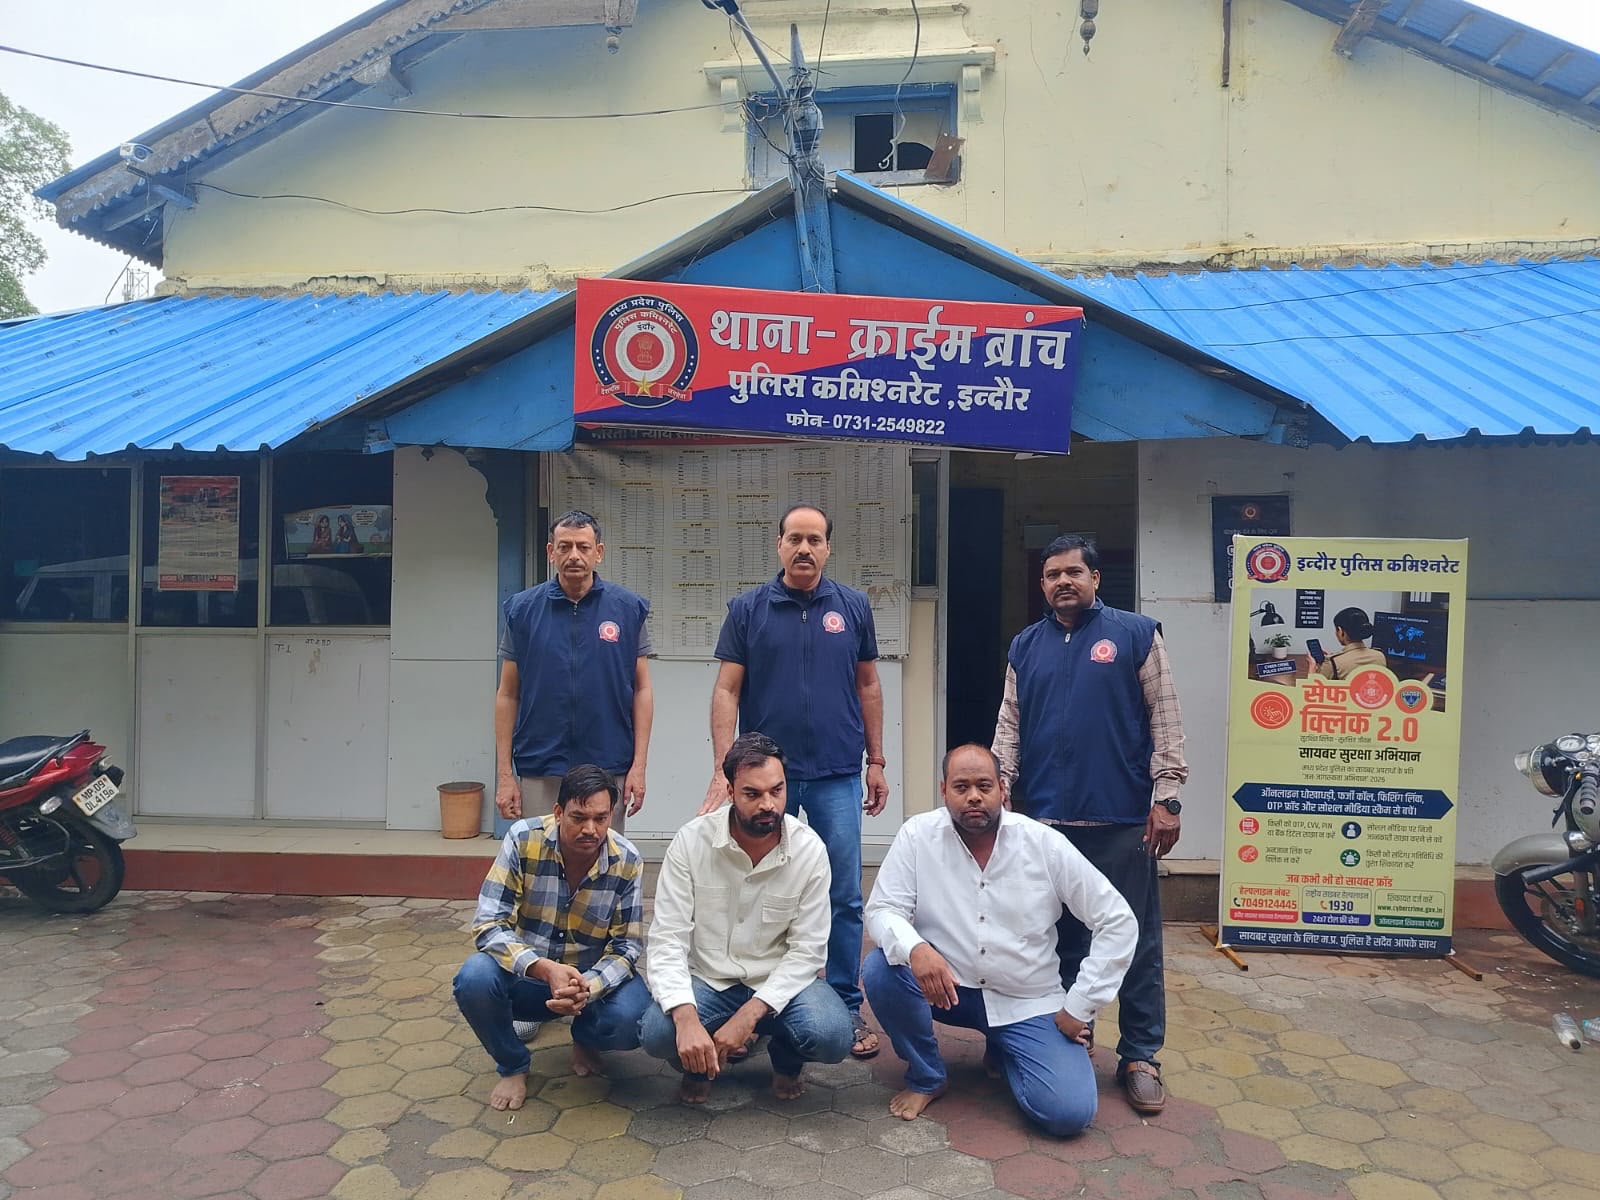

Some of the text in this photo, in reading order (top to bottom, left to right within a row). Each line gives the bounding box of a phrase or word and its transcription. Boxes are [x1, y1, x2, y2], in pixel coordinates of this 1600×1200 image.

[609, 296, 684, 322] मध्य प्रदेश पुलिस
[614, 312, 638, 332] पुलिस
[847, 305, 978, 371] क्राईम
[984, 311, 1072, 369] ब्रांच
[728, 362, 807, 404] पुलिस
[811, 367, 942, 406] कमिश्नरेट
[833, 414, 945, 435] 0731-2549822
[1297, 552, 1336, 571] इन्दौर
[1340, 553, 1383, 576] पुलिस
[1387, 554, 1459, 573] कमिश्नरेट
[1302, 679, 1350, 703] सेफ
[1299, 704, 1418, 742] क्लिक 2.0
[1298, 747, 1421, 763] सायबर सुरक्षा अभियान
[1261, 788, 1299, 798] ऑनलाइन
[1337, 789, 1355, 800] फर्जी
[1267, 802, 1283, 810] OTP
[1284, 801, 1300, 811] फ्रॉड
[1302, 802, 1316, 812] और
[1318, 802, 1343, 813] सोशल
[1344, 802, 1370, 814] मीडिया
[1372, 803, 1391, 814] स्कैम
[1392, 805, 1401, 814] से
[1286, 873, 1393, 887] जब कभी भी हो सायबर फ्रॉड
[1238, 886, 1290, 896] हेल्पलाइन नंबर
[1241, 898, 1297, 909] 7049124445
[1328, 900, 1353, 911] 1930
[1239, 931, 1266, 941] सायबर
[1269, 932, 1292, 944] सुरक्षा
[1293, 931, 1301, 943] के
[1303, 932, 1319, 944] लिए
[1340, 934, 1364, 948] पुलिस
[1365, 934, 1372, 946] है
[1374, 935, 1392, 947] सदैव
[1394, 937, 1417, 948] आपके
[1419, 938, 1437, 949] साथ
